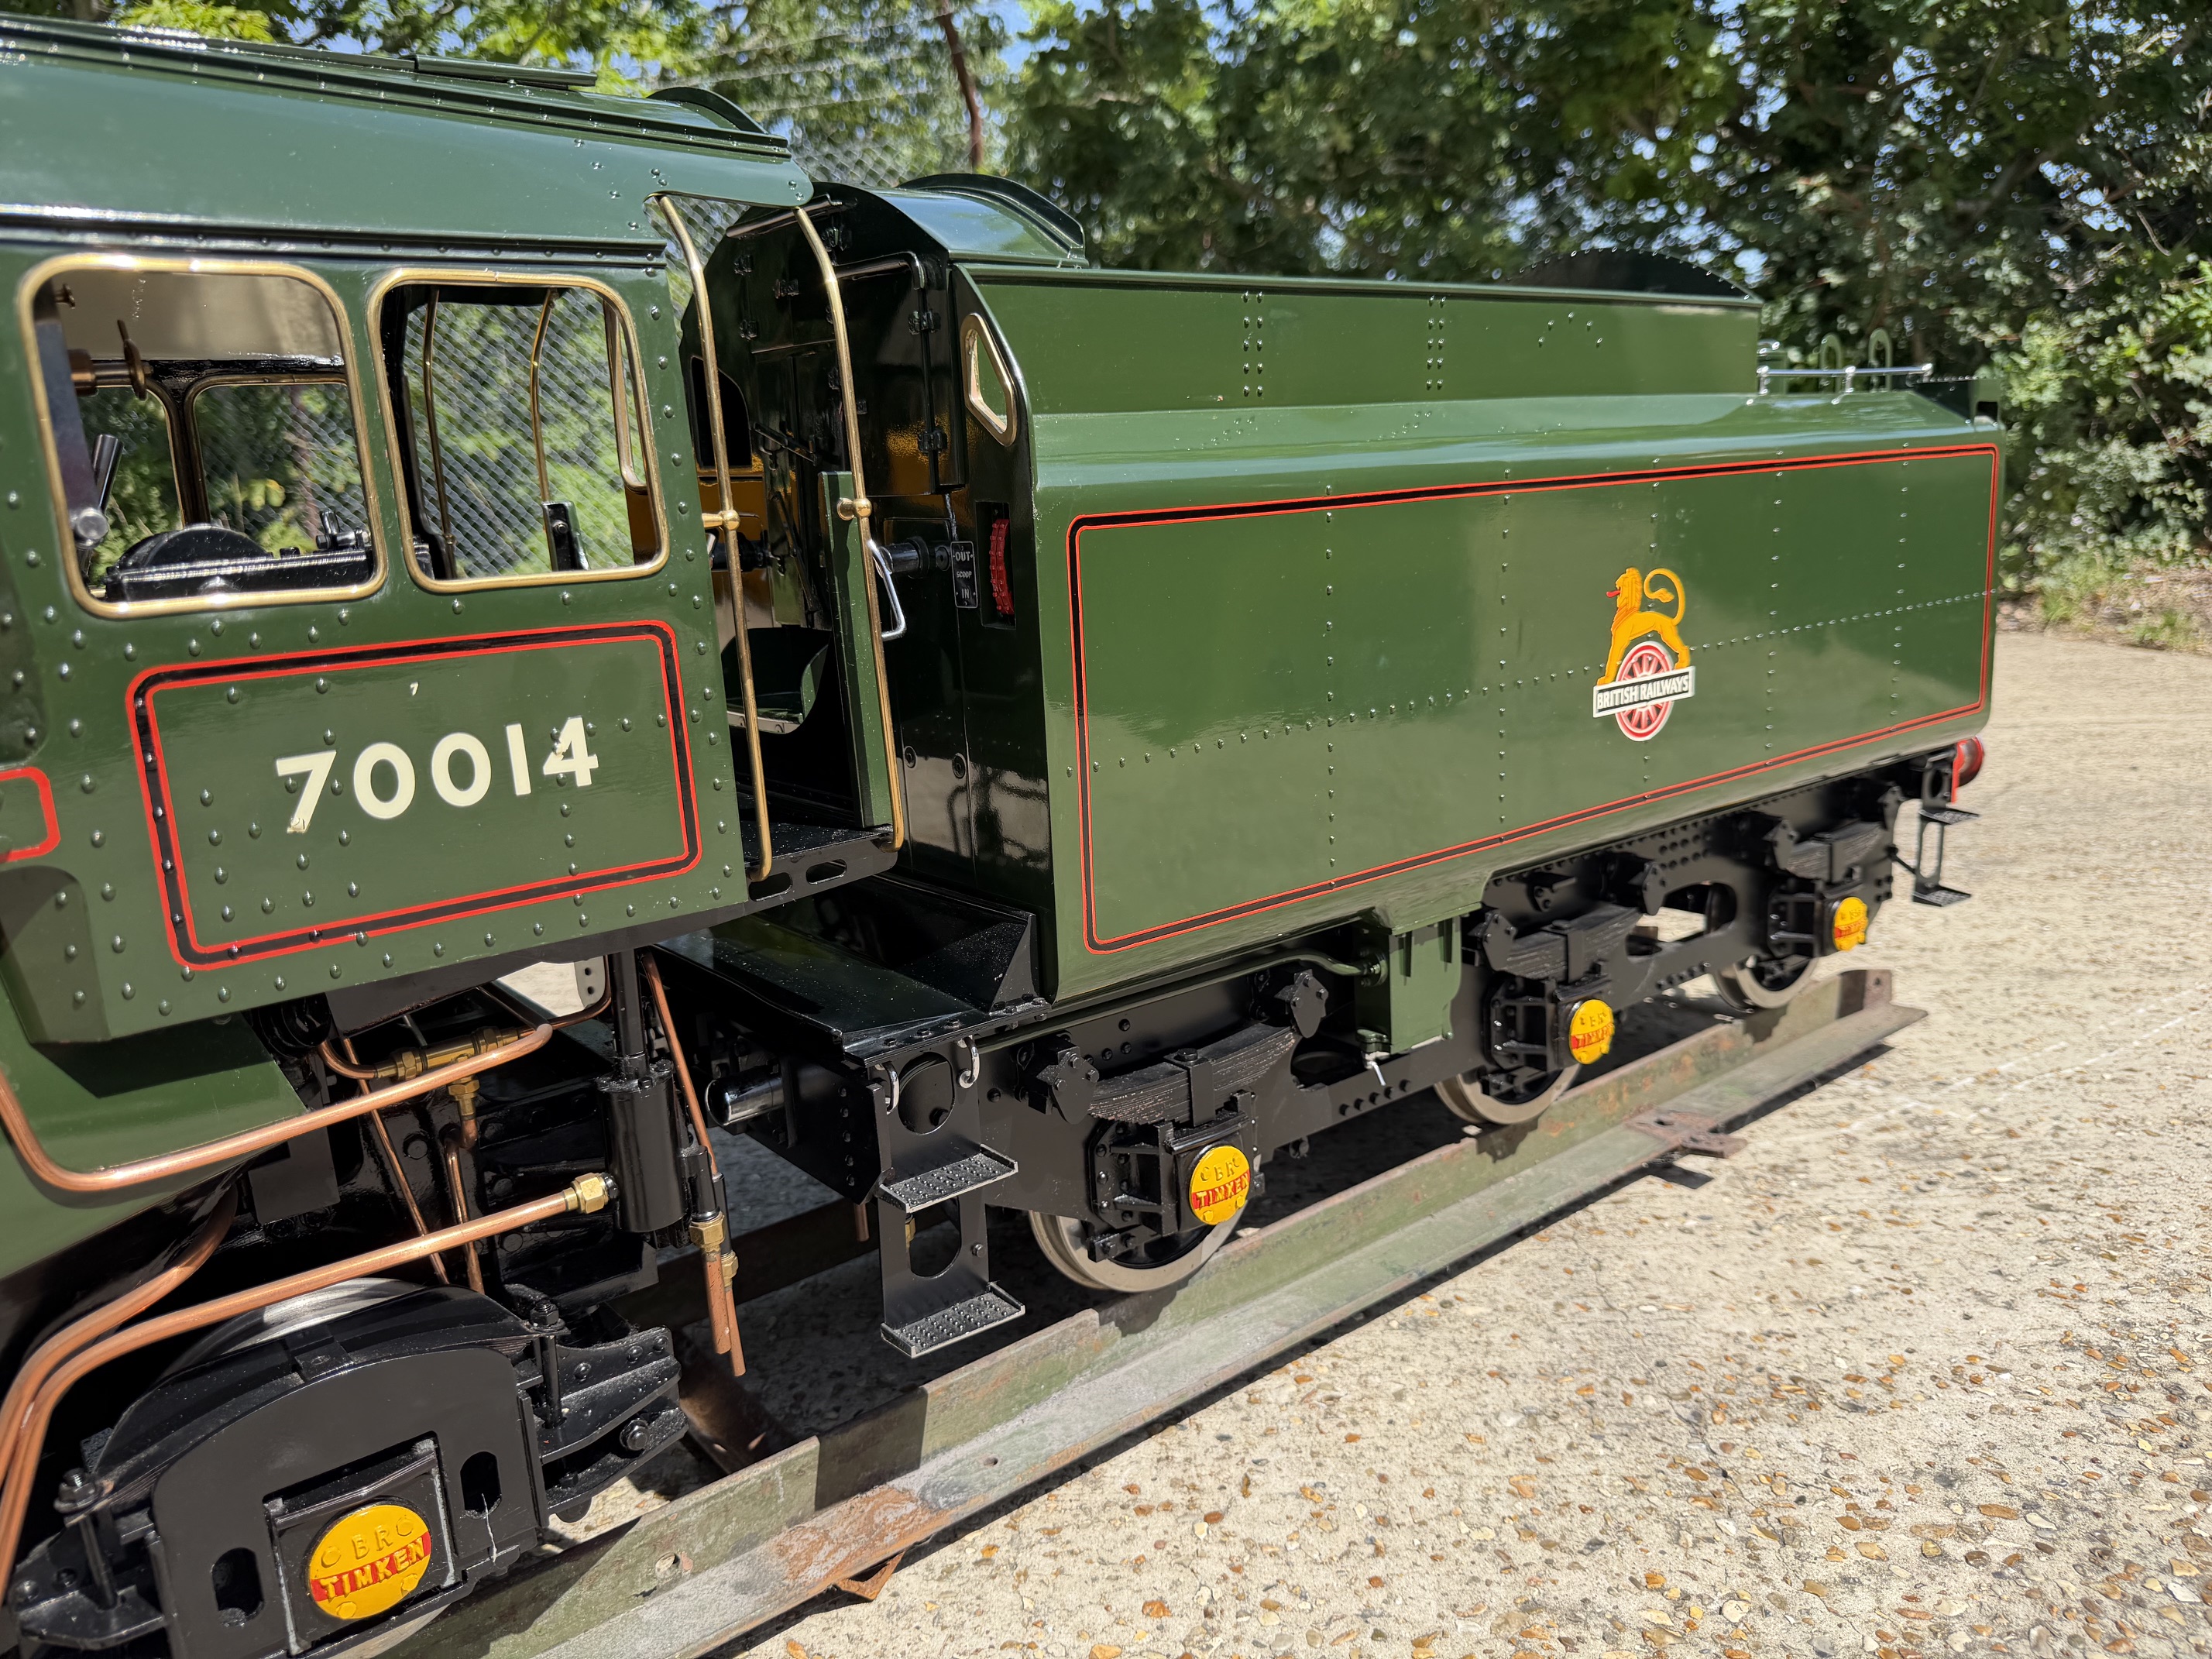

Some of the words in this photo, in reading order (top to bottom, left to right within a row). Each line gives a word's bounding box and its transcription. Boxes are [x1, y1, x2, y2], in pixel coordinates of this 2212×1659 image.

[955, 551, 970, 562] OUT
[956, 571, 972, 579] SCOOP
[961, 589, 970, 599] IN
[1596, 685, 1640, 710] BRITISH
[1640, 675, 1689, 700] RAILWAYS
[275, 716, 599, 834] 70014
[319, 1537, 426, 1601] TIMKEN
